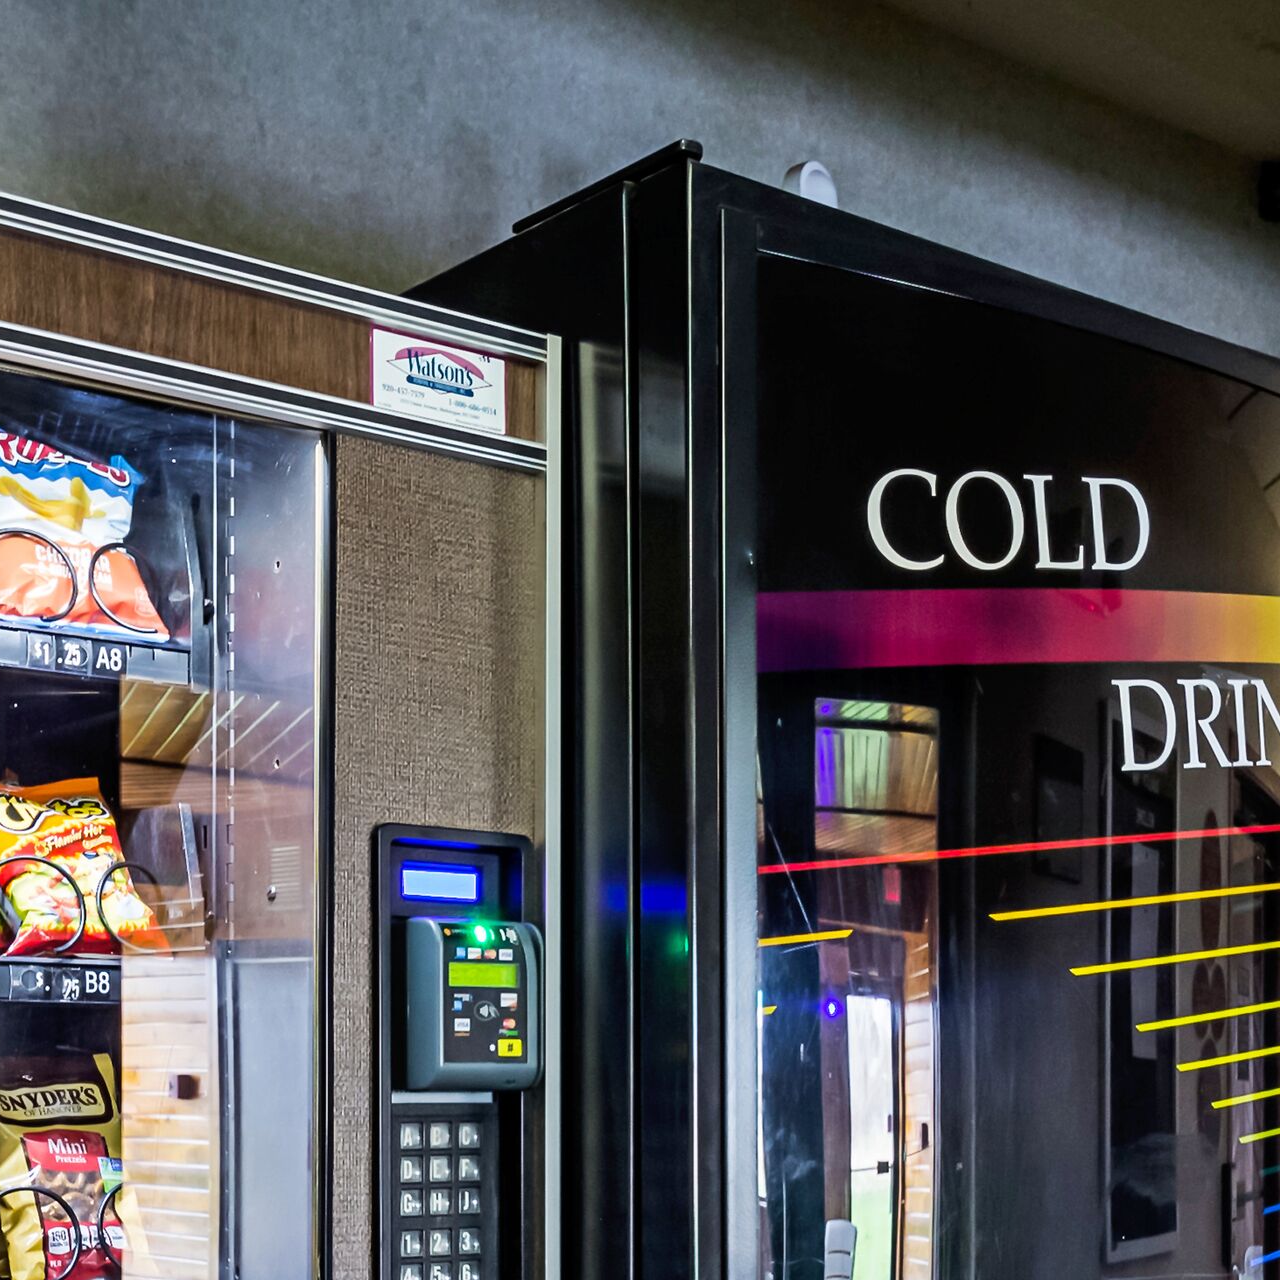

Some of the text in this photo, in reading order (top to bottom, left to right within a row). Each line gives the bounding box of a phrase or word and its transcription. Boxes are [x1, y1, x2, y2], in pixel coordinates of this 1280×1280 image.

[406, 347, 473, 388] Watson's
[867, 468, 1150, 571] COLD
[95, 646, 122, 672] A8
[83, 823, 105, 837] Hot
[85, 970, 110, 994] B8
[23, 1104, 83, 1117] OF HANOVER
[404, 1127, 413, 1145] A
[48, 1138, 88, 1155] Mini
[55, 1154, 87, 1164] Pretzels
[404, 1161, 413, 1179] D
[404, 1194, 413, 1213] G
[404, 1235, 411, 1253] 1
[462, 1233, 470, 1251] 3
